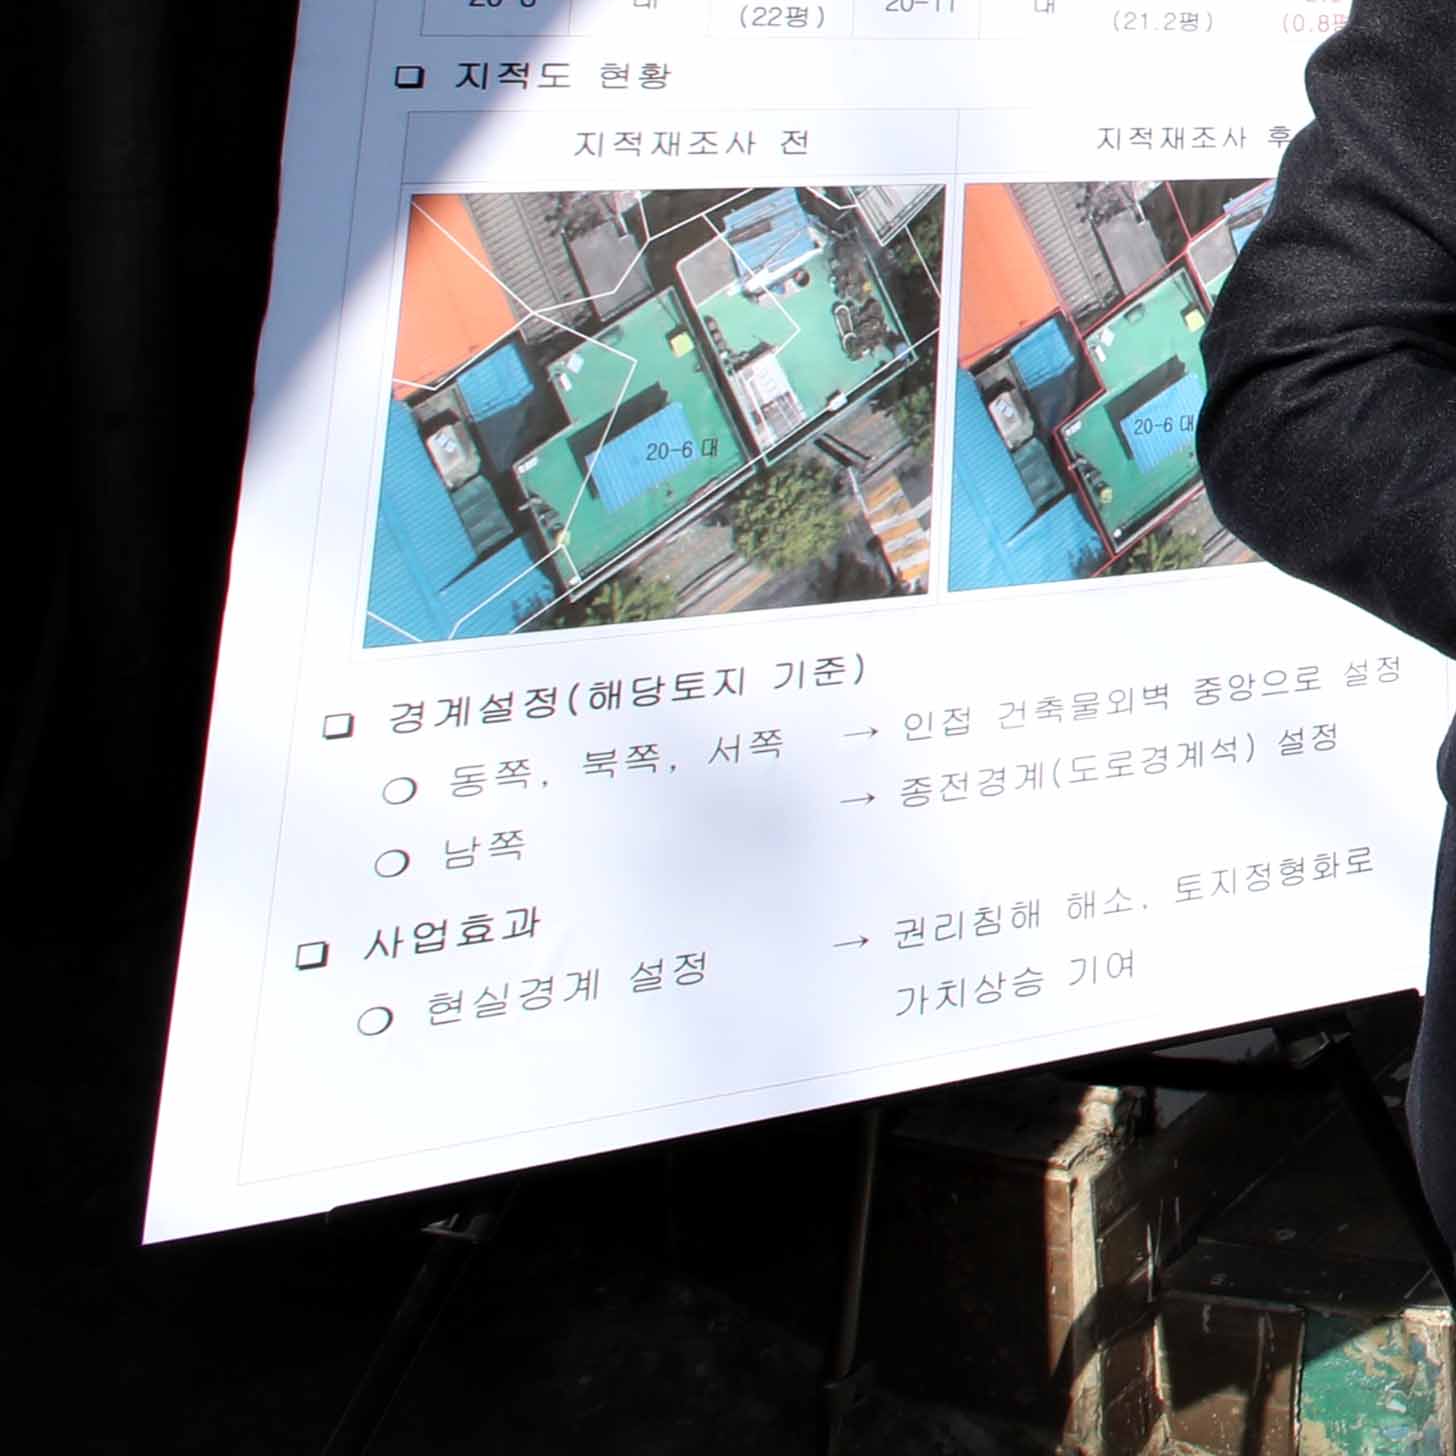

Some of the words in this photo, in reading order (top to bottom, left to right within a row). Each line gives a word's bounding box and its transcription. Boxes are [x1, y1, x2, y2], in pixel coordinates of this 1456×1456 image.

[740, 5, 824, 29] (22평)
[1114, 11, 1212, 32] (21.2평)
[456, 62, 571, 90] 지적도
[600, 63, 672, 90] 현황
[574, 131, 757, 158] 지적재조사
[780, 130, 808, 155] 전
[1097, 127, 1247, 151] 지적재조사
[1267, 124, 1293, 148] 후
[1133, 417, 1173, 435] 20-6
[646, 440, 694, 462] 20-6
[701, 438, 718, 456] 대
[388, 666, 746, 735] 경계설정(해당토지
[773, 653, 864, 690] 기준)
[904, 707, 970, 741] 인접
[997, 682, 1171, 731] 건축물외벽
[1192, 664, 1322, 706] 중앙으로
[1344, 656, 1399, 687] 설정
[448, 758, 549, 800] 동쪽,
[708, 729, 783, 764] 서쪽
[899, 732, 1256, 809] 종전경계(도로경계석)
[1278, 723, 1336, 756] 설정
[445, 829, 525, 870] 남쪽
[894, 899, 1039, 949] 권리침해
[1176, 847, 1373, 903] 토지정형화로
[363, 906, 541, 960] 사업효과
[428, 968, 599, 1026] 현실경계
[630, 952, 706, 993] 설정
[896, 967, 1044, 1016] 가치상승
[1069, 949, 1133, 986] 기여
